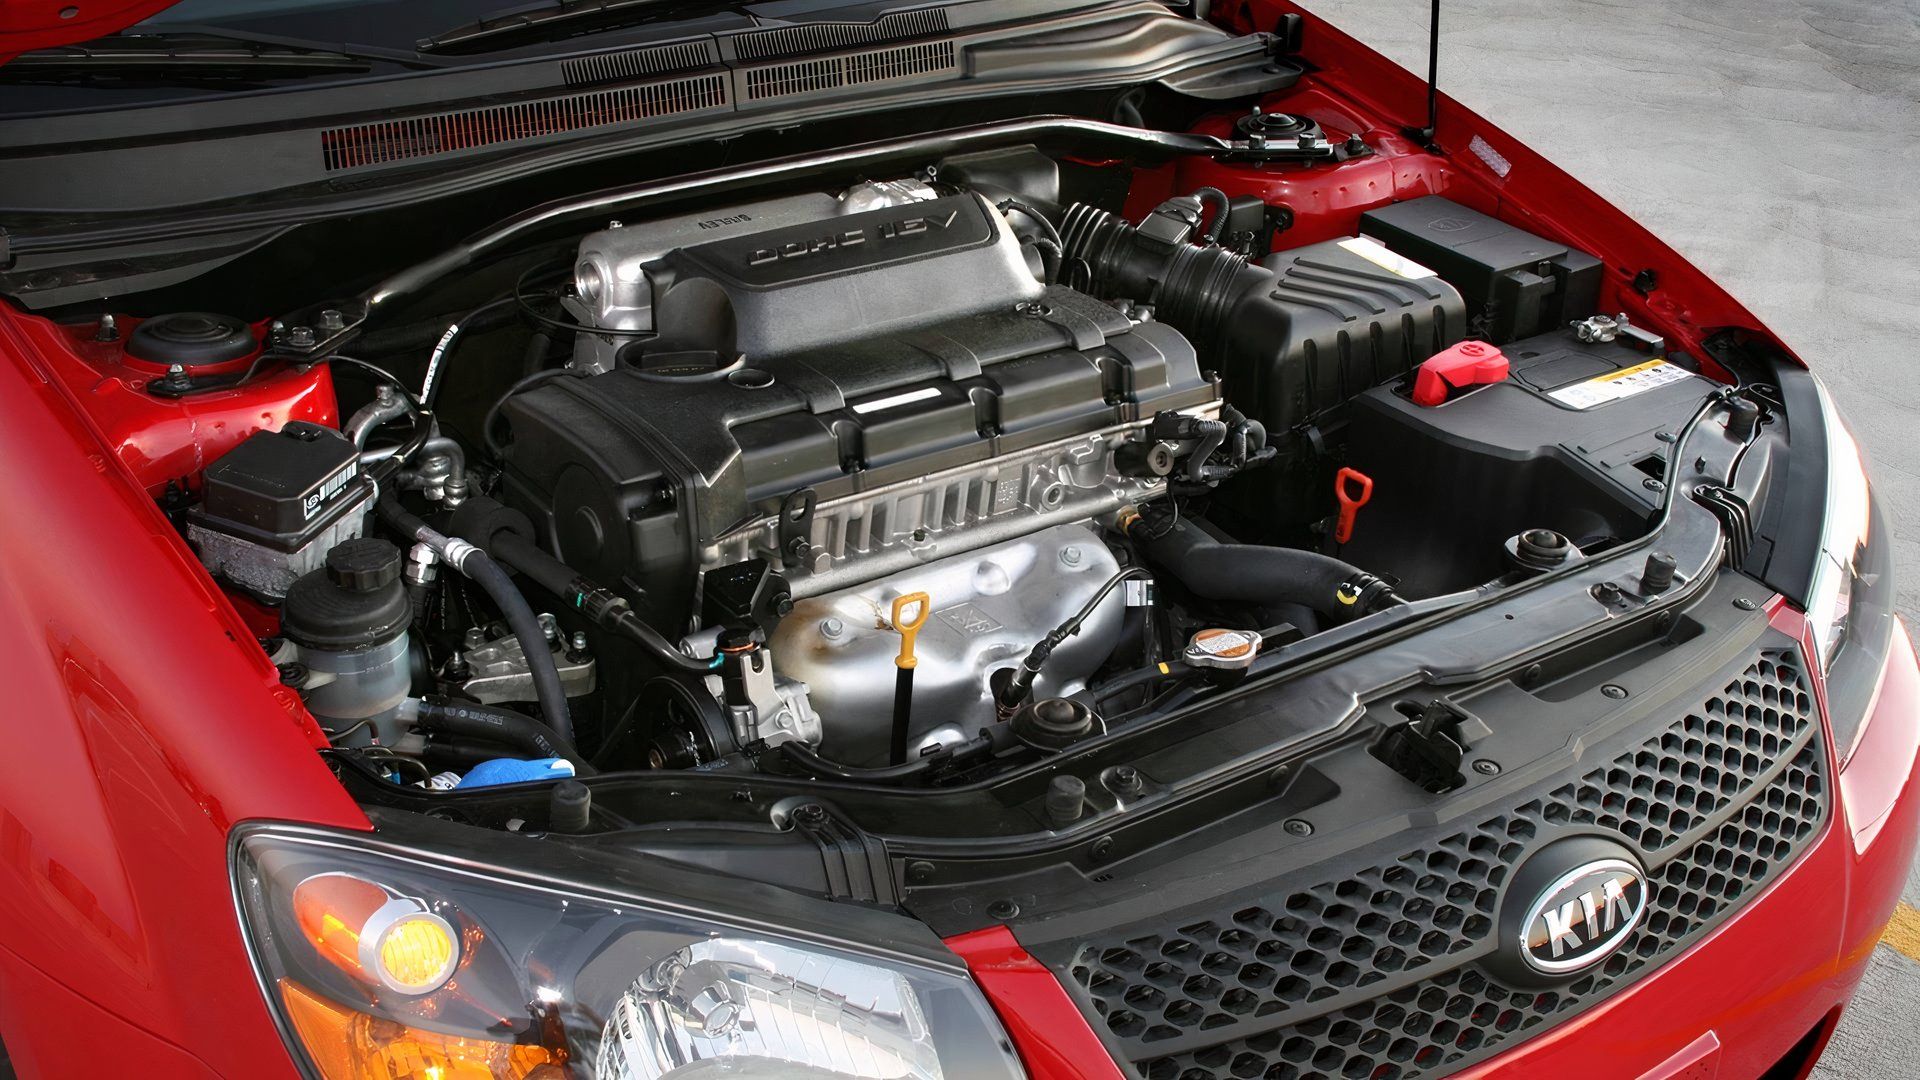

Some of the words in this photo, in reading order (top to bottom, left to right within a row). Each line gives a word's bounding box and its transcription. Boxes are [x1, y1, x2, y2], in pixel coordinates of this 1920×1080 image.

[748, 229, 866, 266] DOHC
[877, 210, 958, 239] 16V
[1542, 878, 1633, 958] KIA
